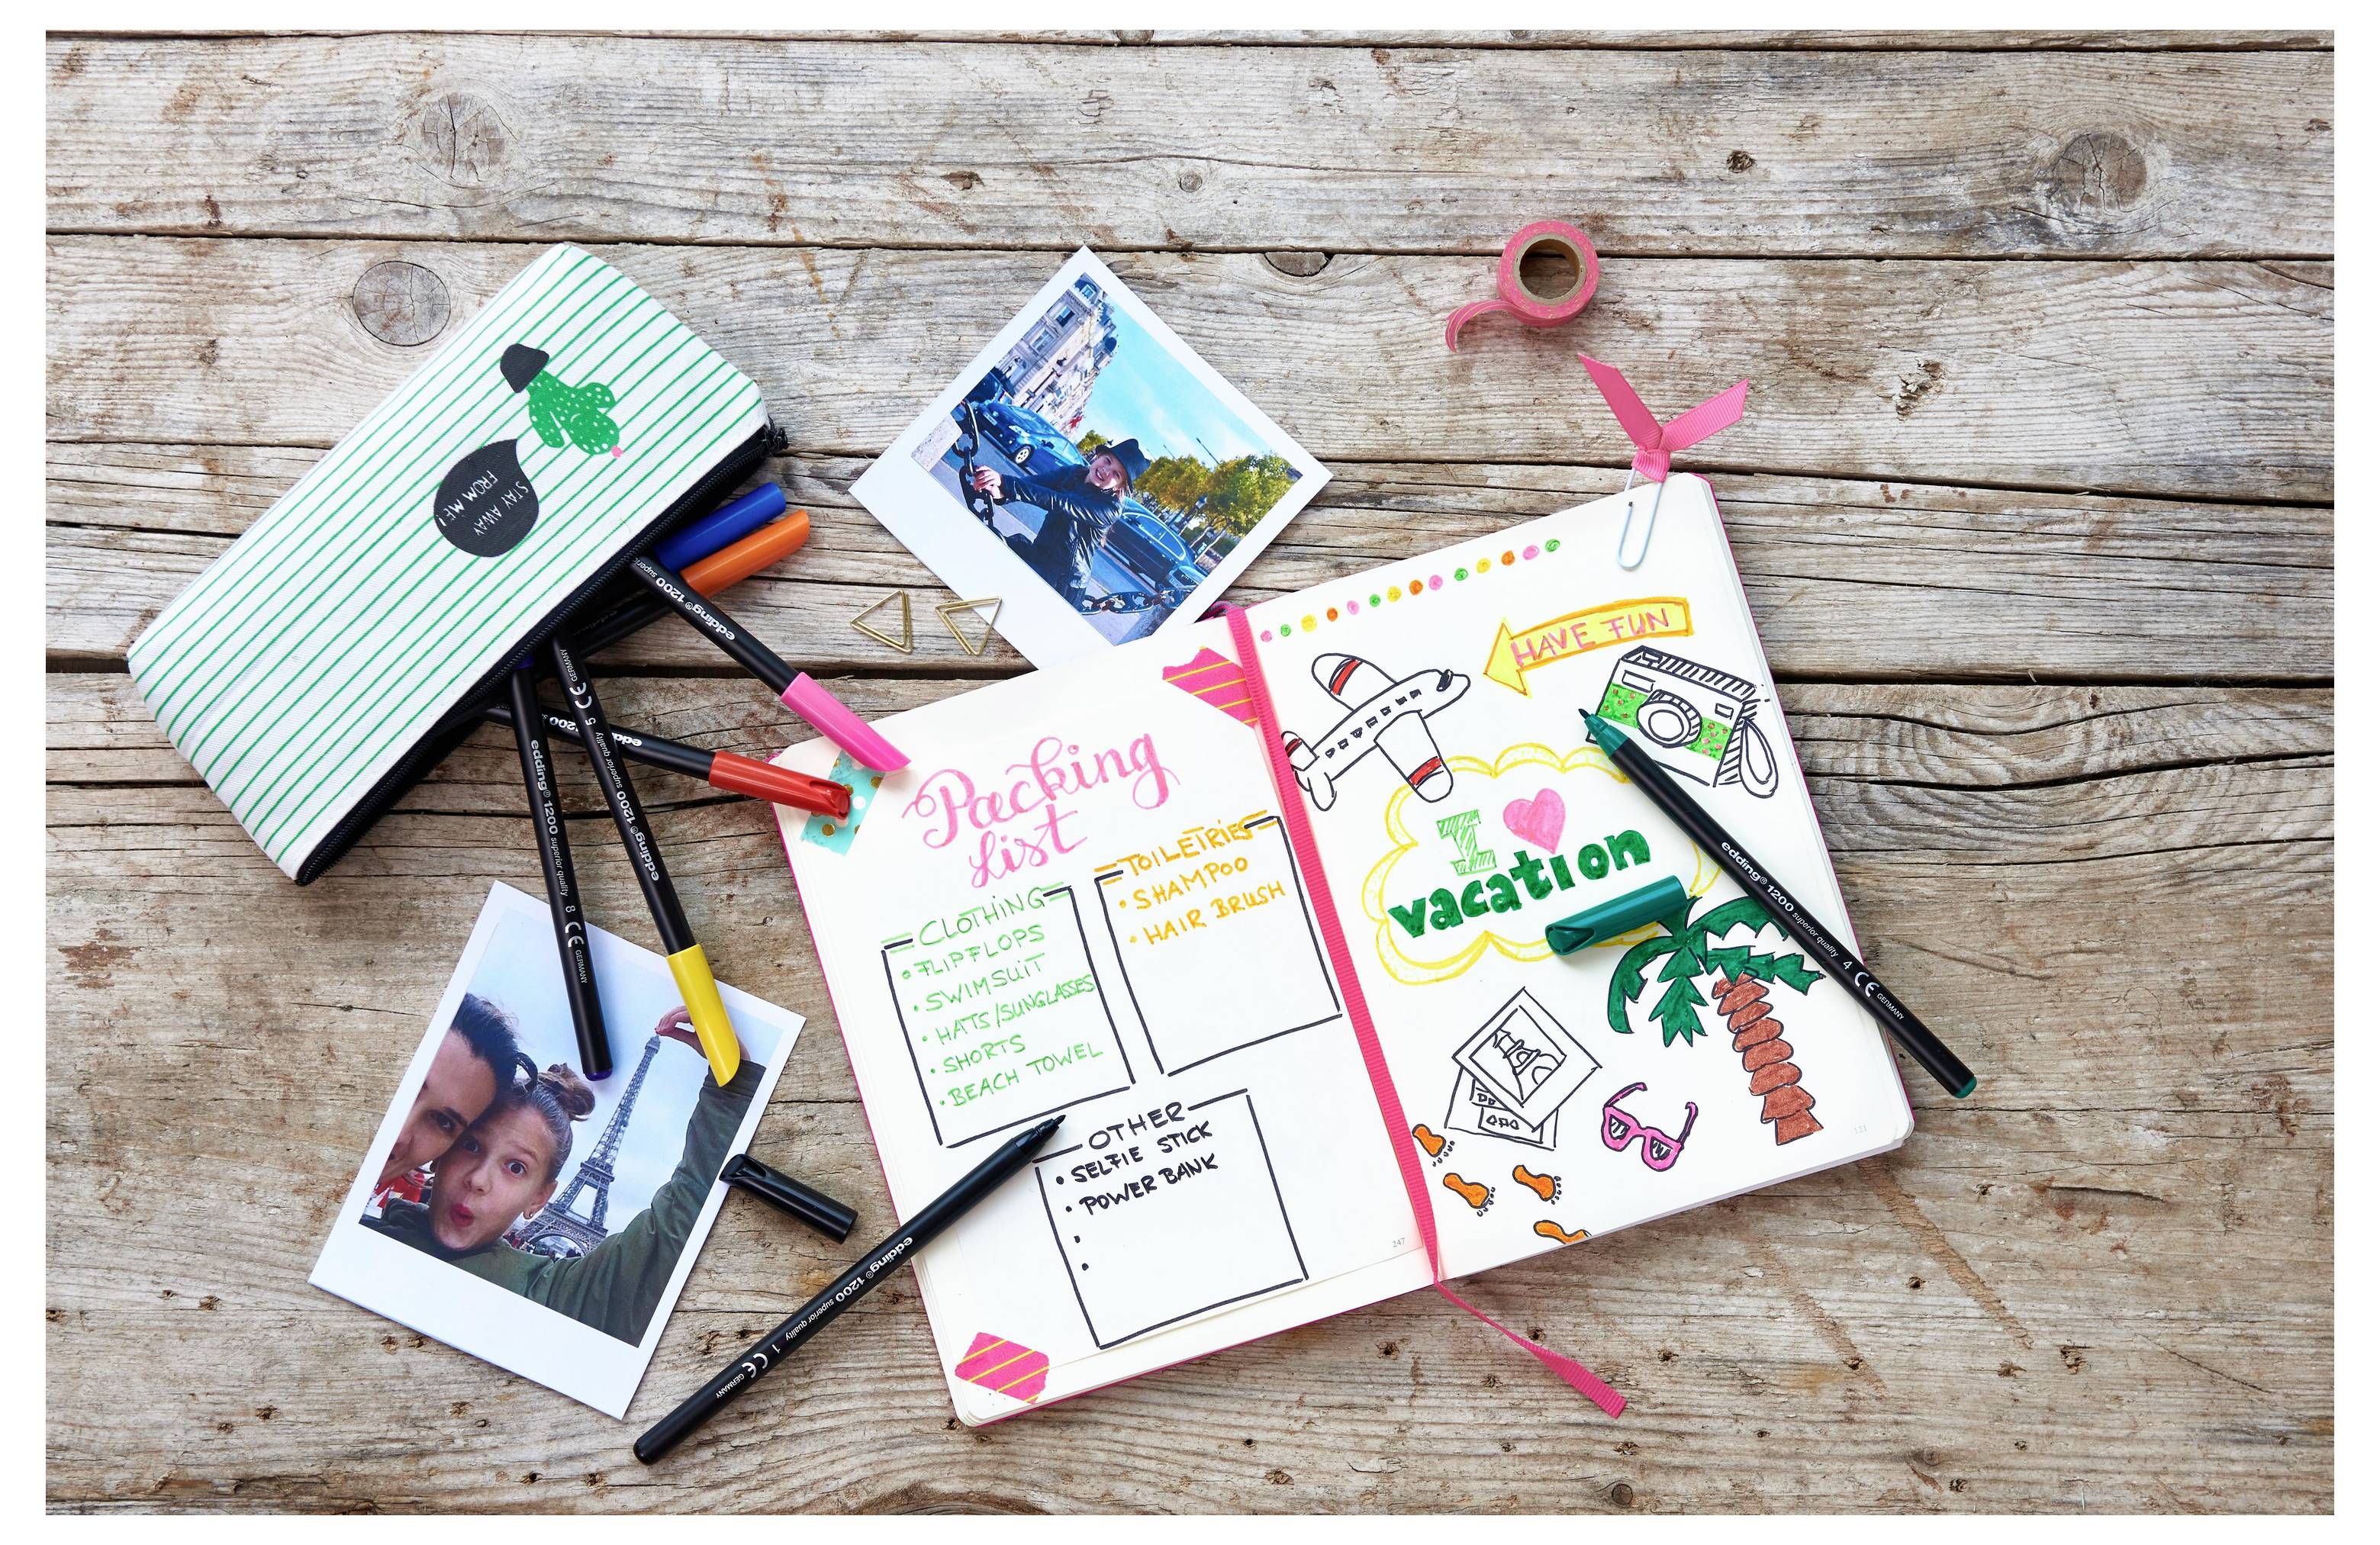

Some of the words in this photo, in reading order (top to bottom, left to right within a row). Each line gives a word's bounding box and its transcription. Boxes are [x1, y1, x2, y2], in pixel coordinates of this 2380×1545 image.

[462, 470, 498, 501] FROM
[501, 481, 528, 510] STAY
[443, 499, 465, 521] ME
[473, 504, 501, 536] AWAY
[655, 577, 685, 604] 1200
[1510, 622, 1596, 667] HAVE
[1600, 608, 1670, 640] FUN
[559, 649, 578, 682] GERMANY
[595, 732, 611, 758] quality
[604, 756, 623, 789] superior
[901, 733, 1180, 848] Packing
[617, 790, 636, 823] 1200
[1116, 815, 1253, 876] TOILETRIES
[1437, 809, 1497, 876] I
[543, 800, 558, 835] 1200
[551, 837, 563, 871] superior
[557, 871, 568, 897] quality
[565, 905, 576, 913] 8
[575, 949, 588, 983] GERMANY
[1132, 857, 1248, 909] SHAMPOO
[1387, 829, 1651, 938] vacation
[919, 887, 1045, 945] CLOTHING
[1142, 909, 1207, 945] HAIR
[1210, 880, 1286, 918] BRUSH
[1766, 884, 1795, 912] 1200
[1792, 912, 1818, 938] superior
[1816, 935, 1839, 958] quality
[1843, 961, 1852, 970] 4
[1876, 993, 1905, 1021] GERMANY
[926, 953, 1045, 1012] SWIMSUIT
[943, 1034, 1026, 1073] SHORTS
[948, 1068, 1019, 1106] BEACH
[1026, 1042, 1103, 1074] TOWEL
[1088, 1101, 1185, 1150] OTHER
[1071, 1146, 1143, 1183] SELFIE
[1157, 1120, 1213, 1154] STICK
[1078, 1175, 1158, 1215] POWER
[1158, 1153, 1219, 1185] BANK
[1392, 1237, 1406, 1248] 247
[835, 1275, 865, 1302] 1200
[784, 1319, 808, 1341] quality
[808, 1299, 834, 1325] superior
[715, 1373, 745, 1399] GERMANY
